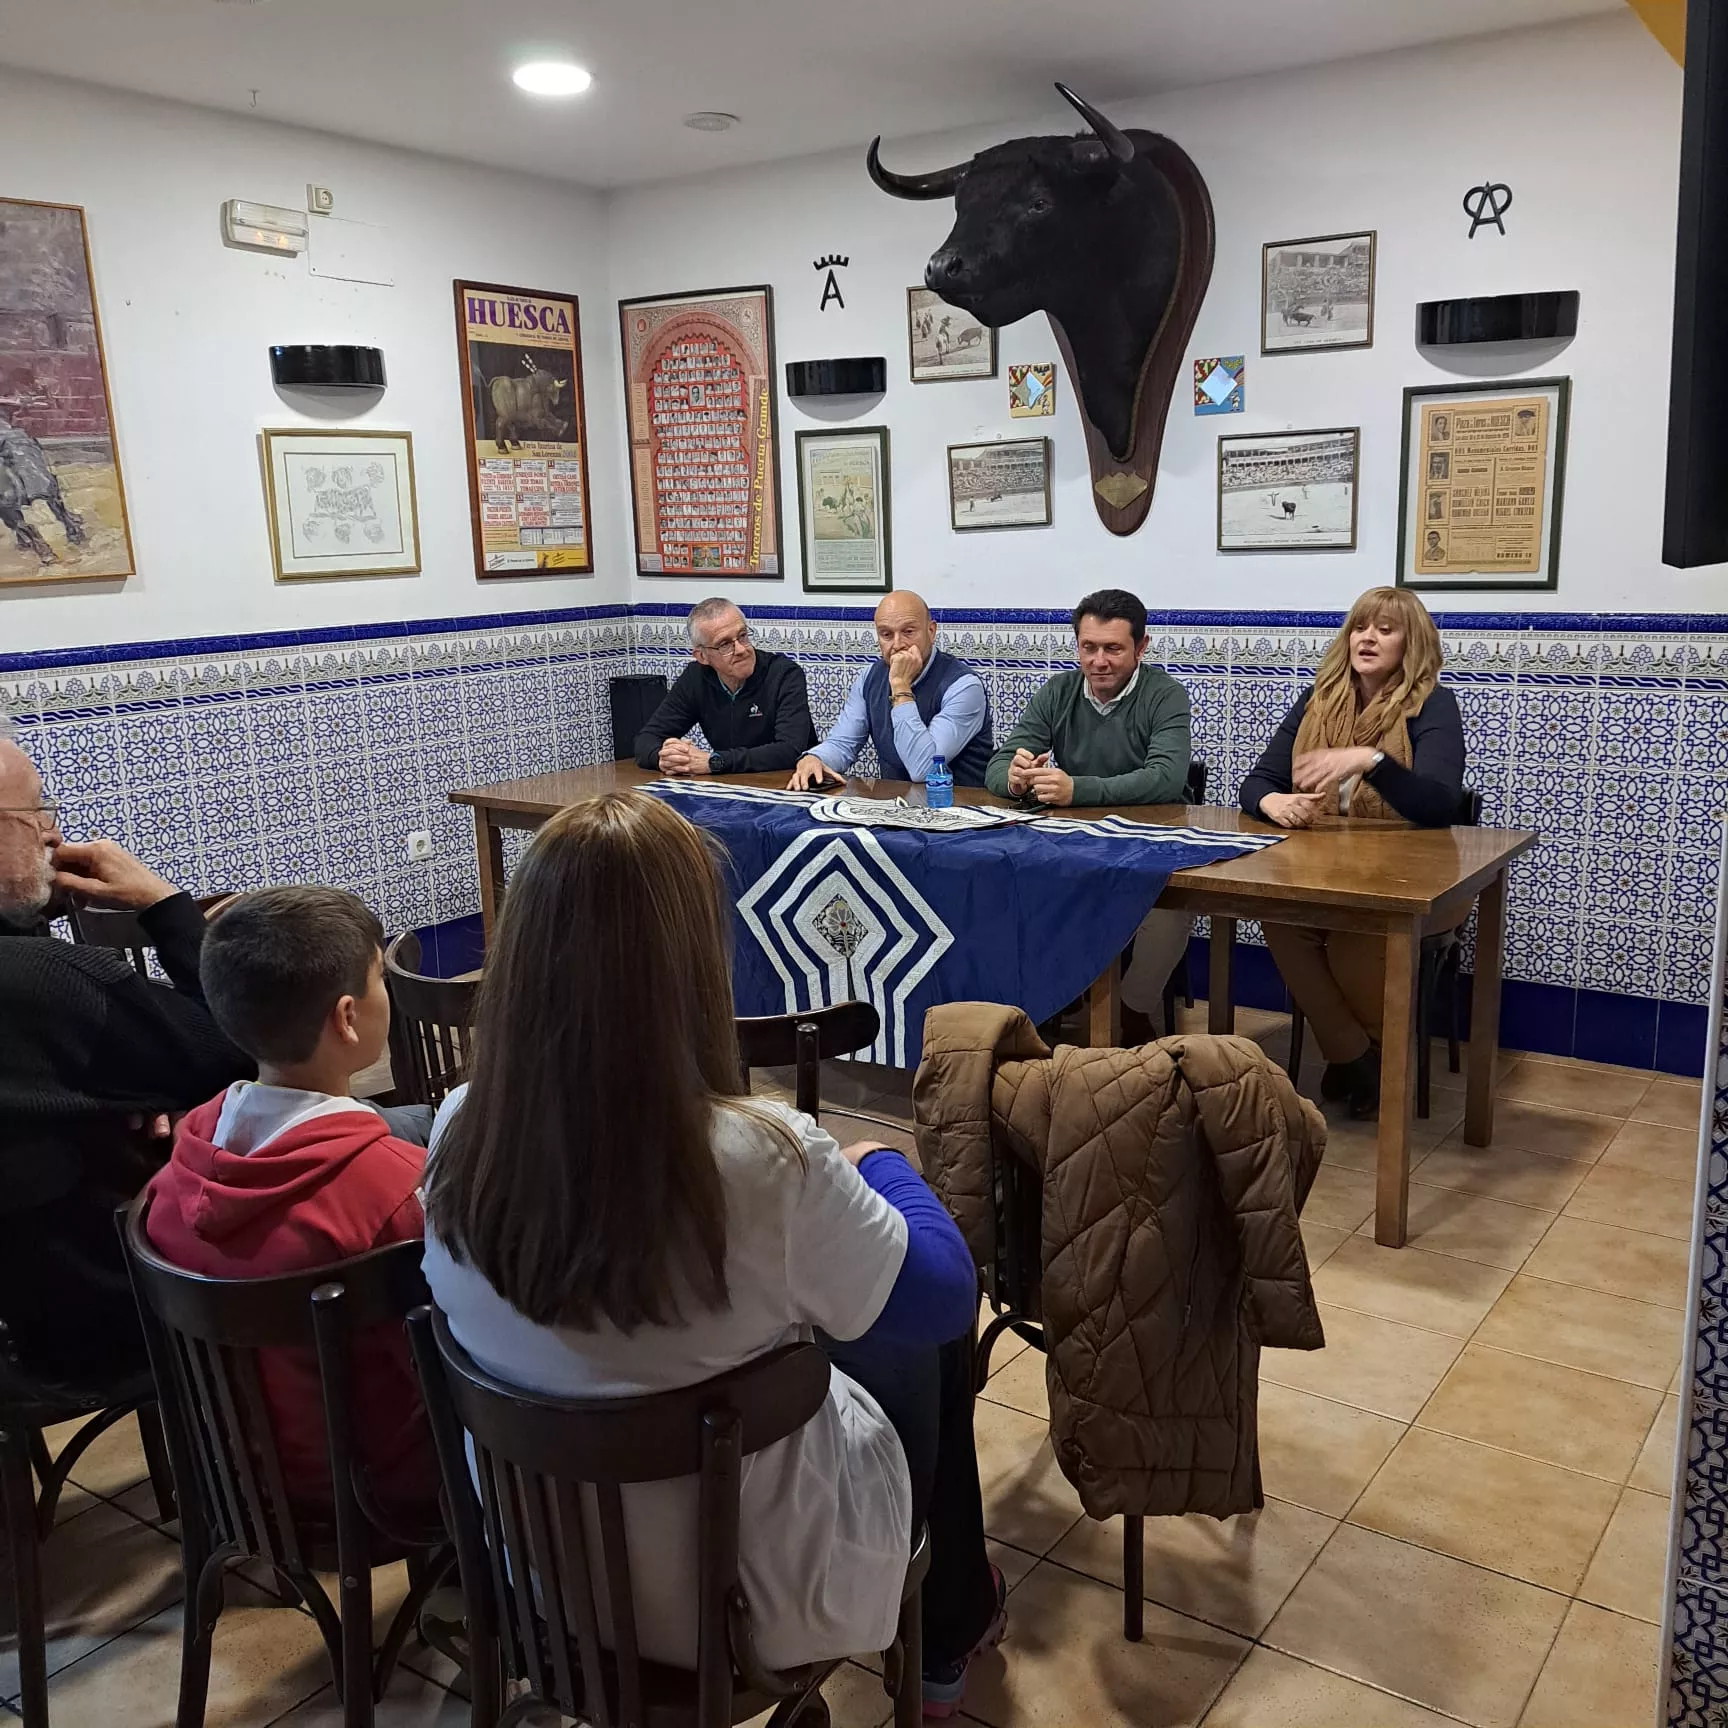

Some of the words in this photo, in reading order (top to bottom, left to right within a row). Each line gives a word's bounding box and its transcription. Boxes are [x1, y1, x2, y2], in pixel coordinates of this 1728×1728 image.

[467, 296, 571, 334] HUESCA
[756, 388, 768, 439] Grande
[754, 444, 766, 490] Puerta
[752, 494, 763, 511] de
[750, 516, 762, 566] Toreros
